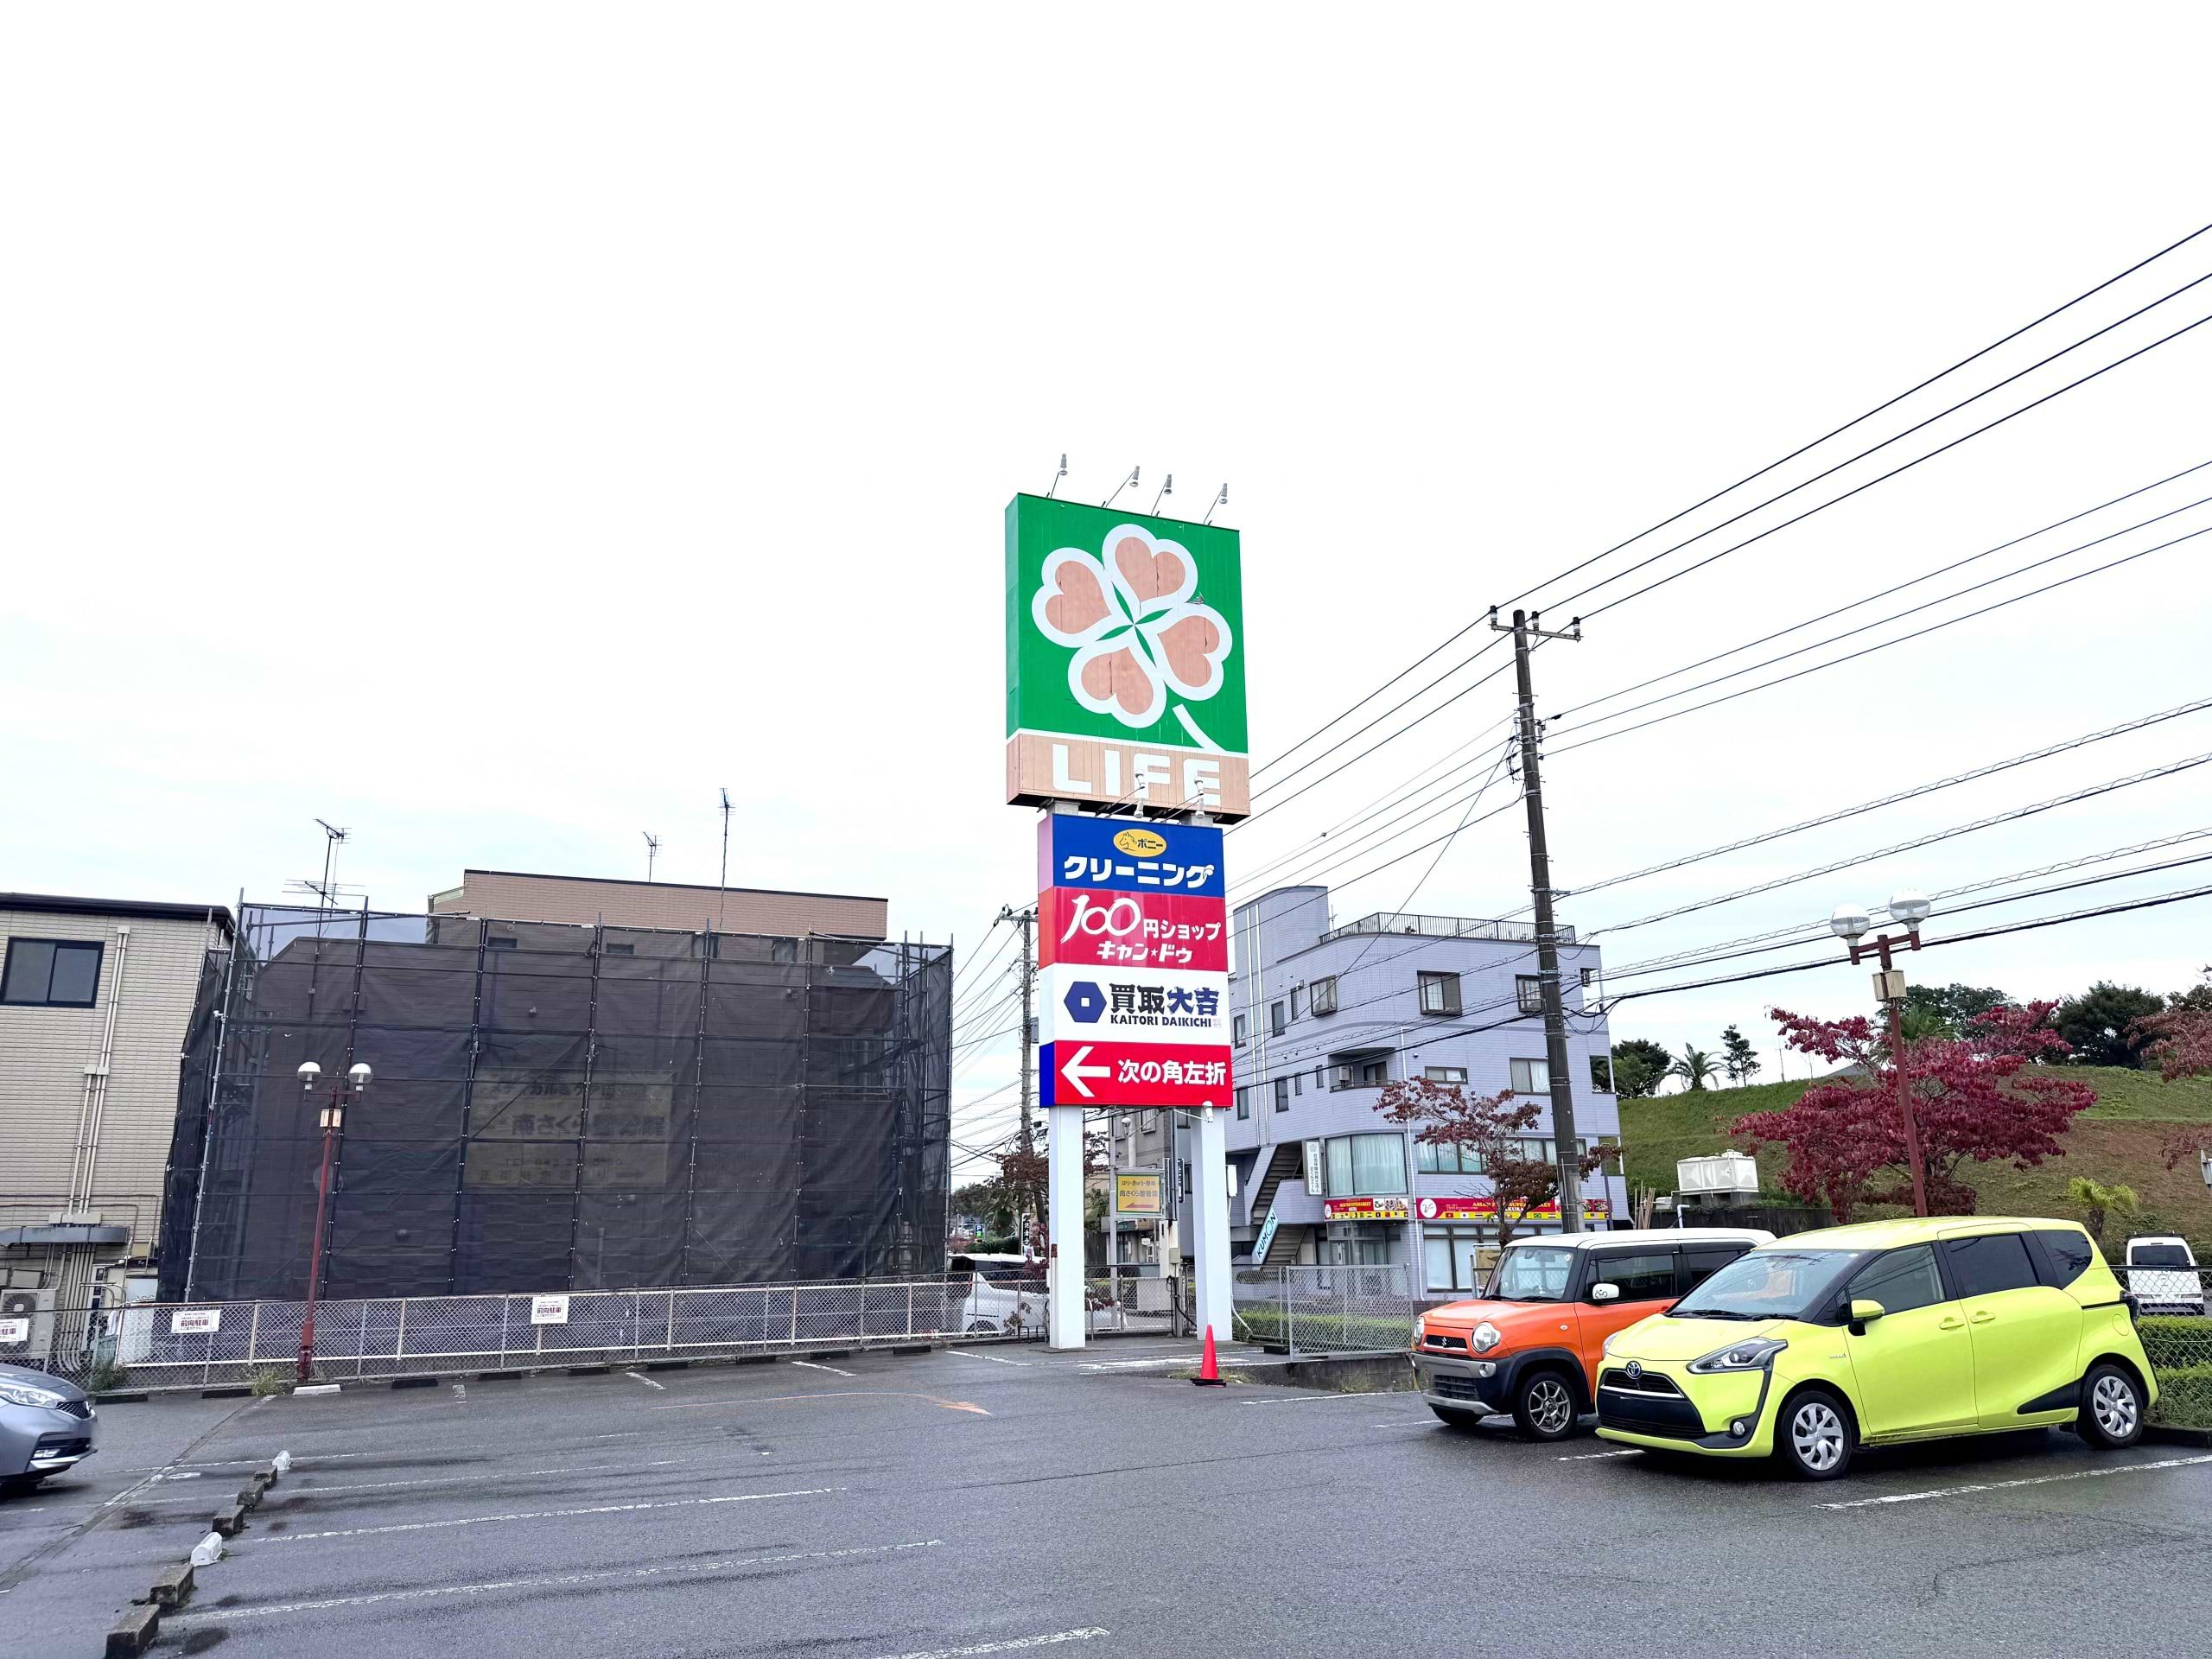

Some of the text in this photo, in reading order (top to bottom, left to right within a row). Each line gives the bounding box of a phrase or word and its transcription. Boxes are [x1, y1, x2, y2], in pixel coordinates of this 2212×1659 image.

[1052, 743, 1221, 807] LIFE
[1137, 838, 1164, 850] ポニー
[1064, 855, 1215, 888] クリーニング
[1109, 982, 1220, 1016] 買取大吉
[1110, 1014, 1159, 1026] KAITORI
[1161, 1016, 1211, 1027] DAIKICHI
[1117, 1058, 1227, 1086] 次の角左折
[1256, 1211, 1276, 1259] KUMON
